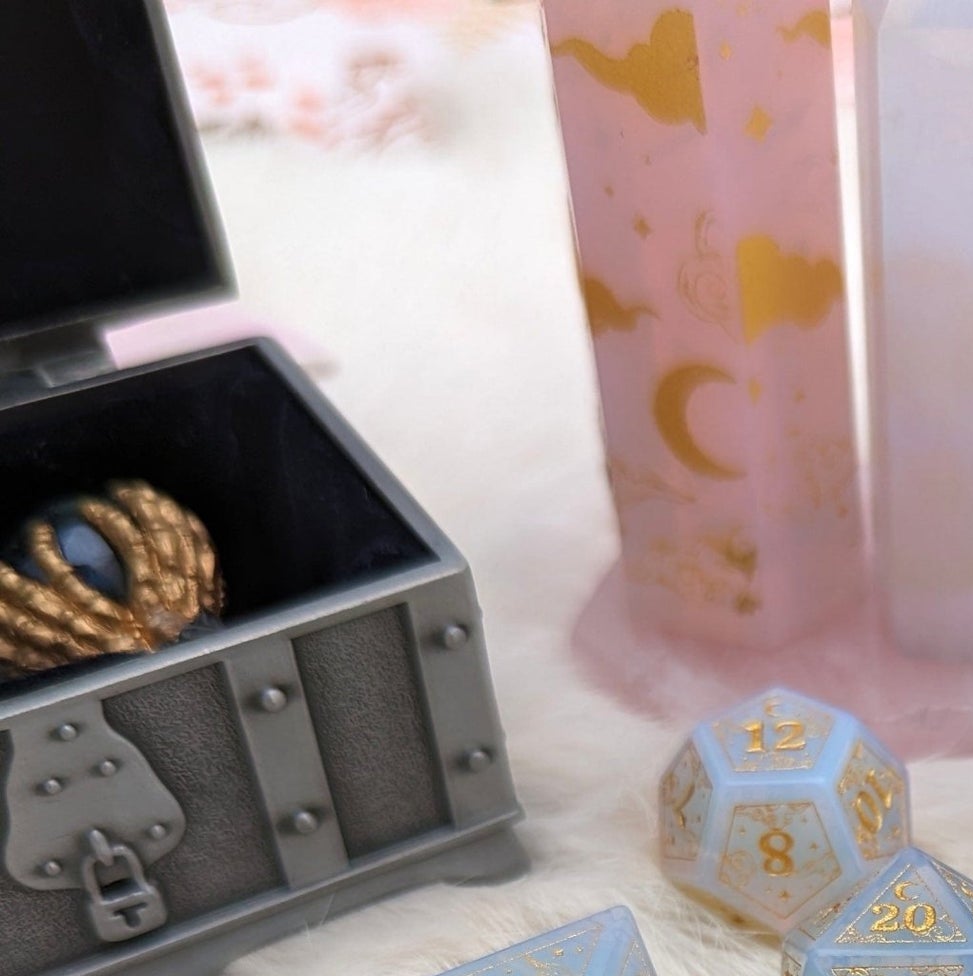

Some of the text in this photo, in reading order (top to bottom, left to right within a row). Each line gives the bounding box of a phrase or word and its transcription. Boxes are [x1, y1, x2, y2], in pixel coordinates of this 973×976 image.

[742, 720, 806, 753] 12
[758, 828, 795, 877] 8
[870, 903, 936, 934] 20
